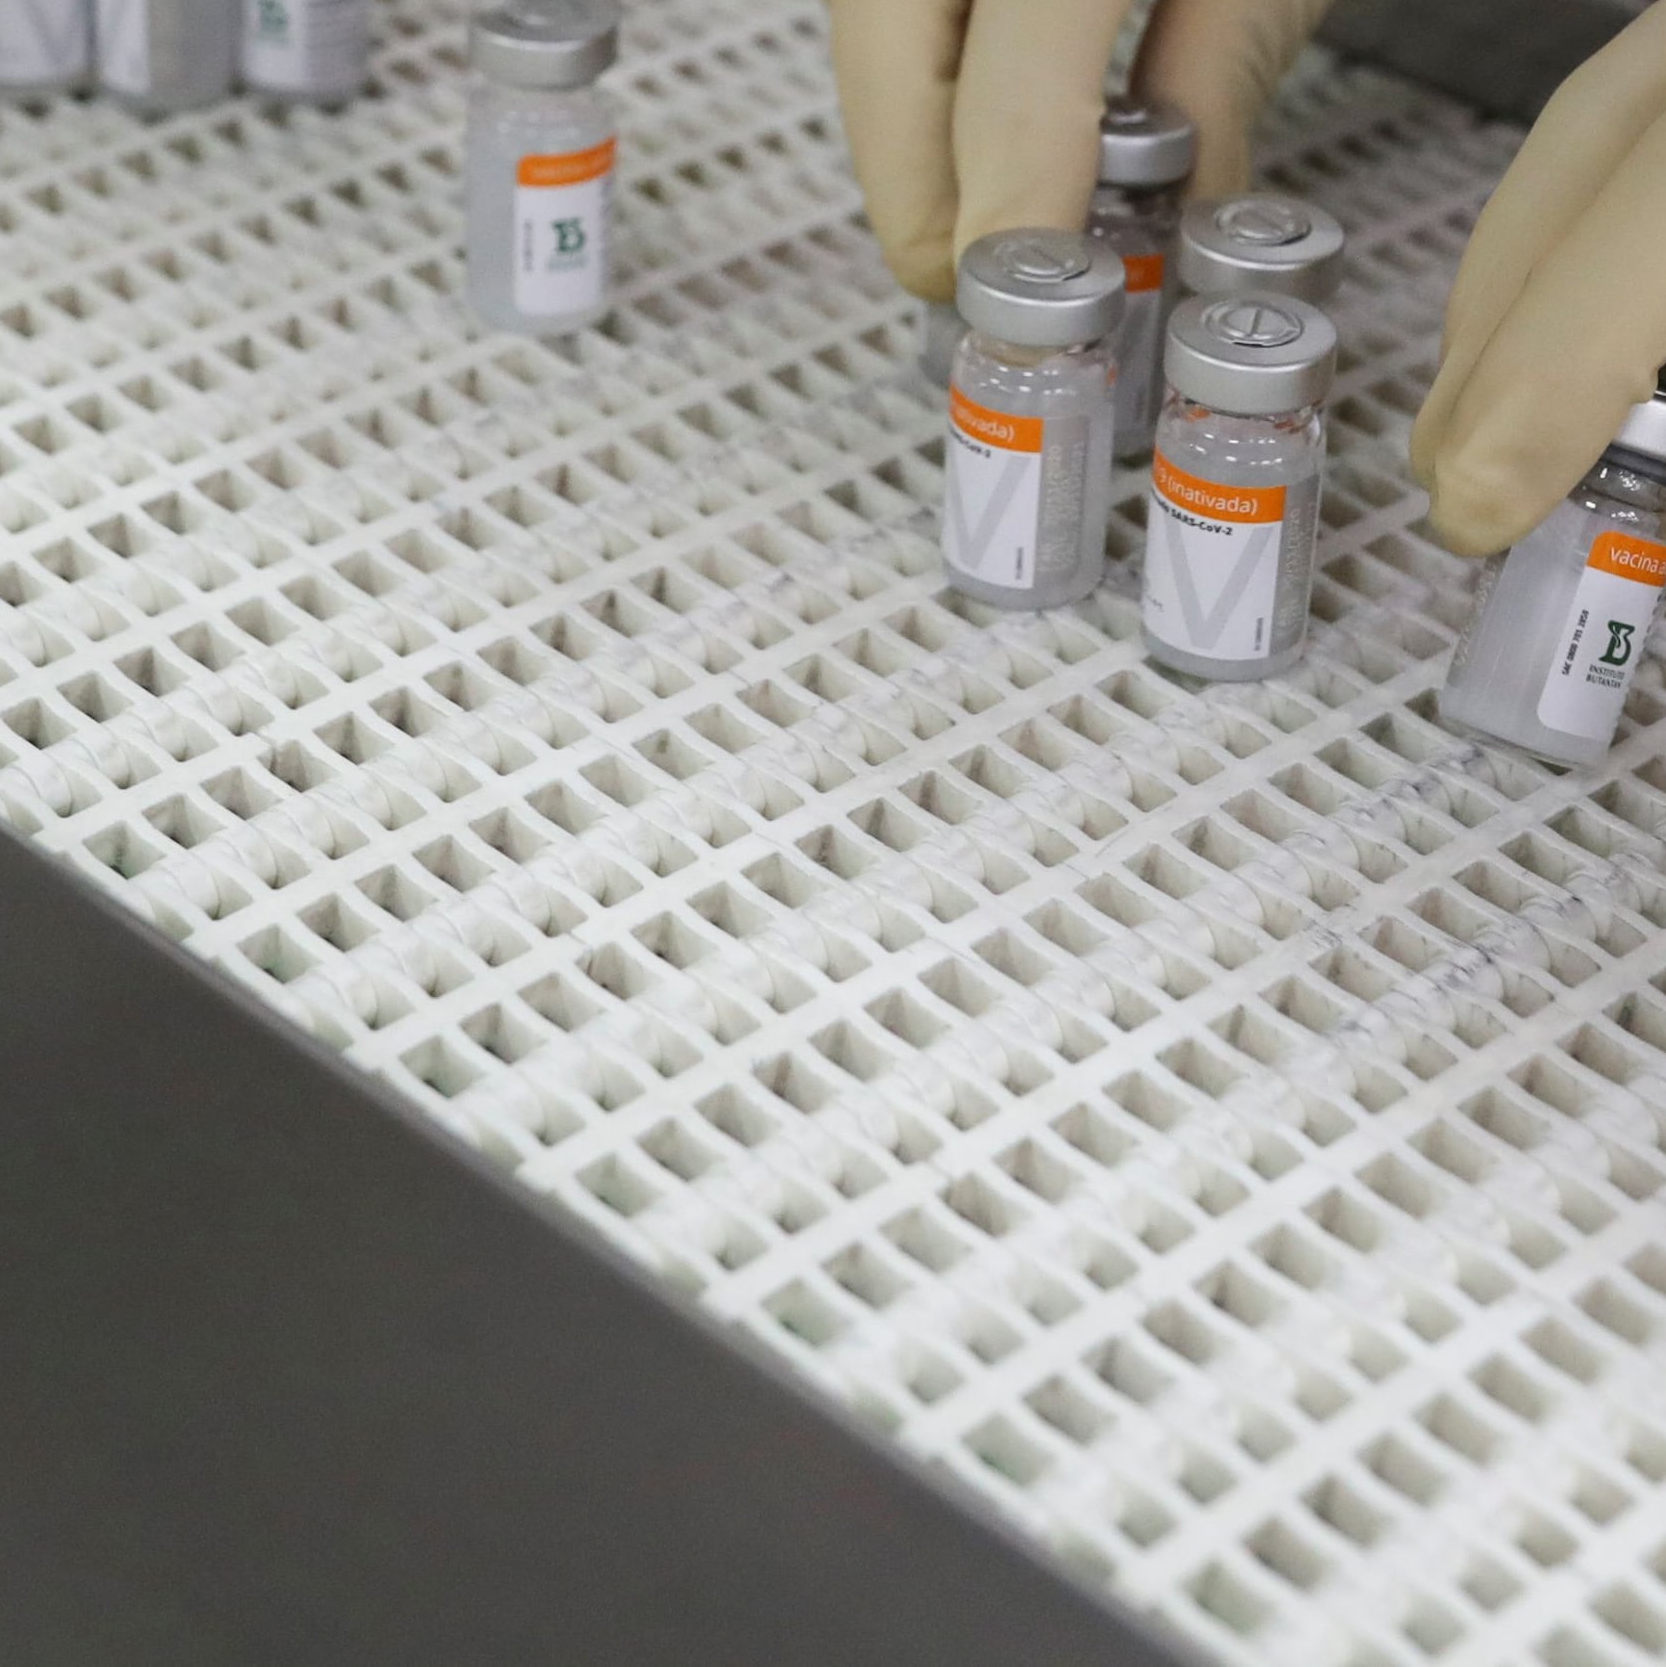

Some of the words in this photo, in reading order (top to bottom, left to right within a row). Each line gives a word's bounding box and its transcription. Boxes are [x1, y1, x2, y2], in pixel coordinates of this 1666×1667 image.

[1168, 475, 1258, 516] (inativada)
[1171, 508, 1233, 536] SARS-CoV-2
[1611, 547, 1659, 573] vacina
